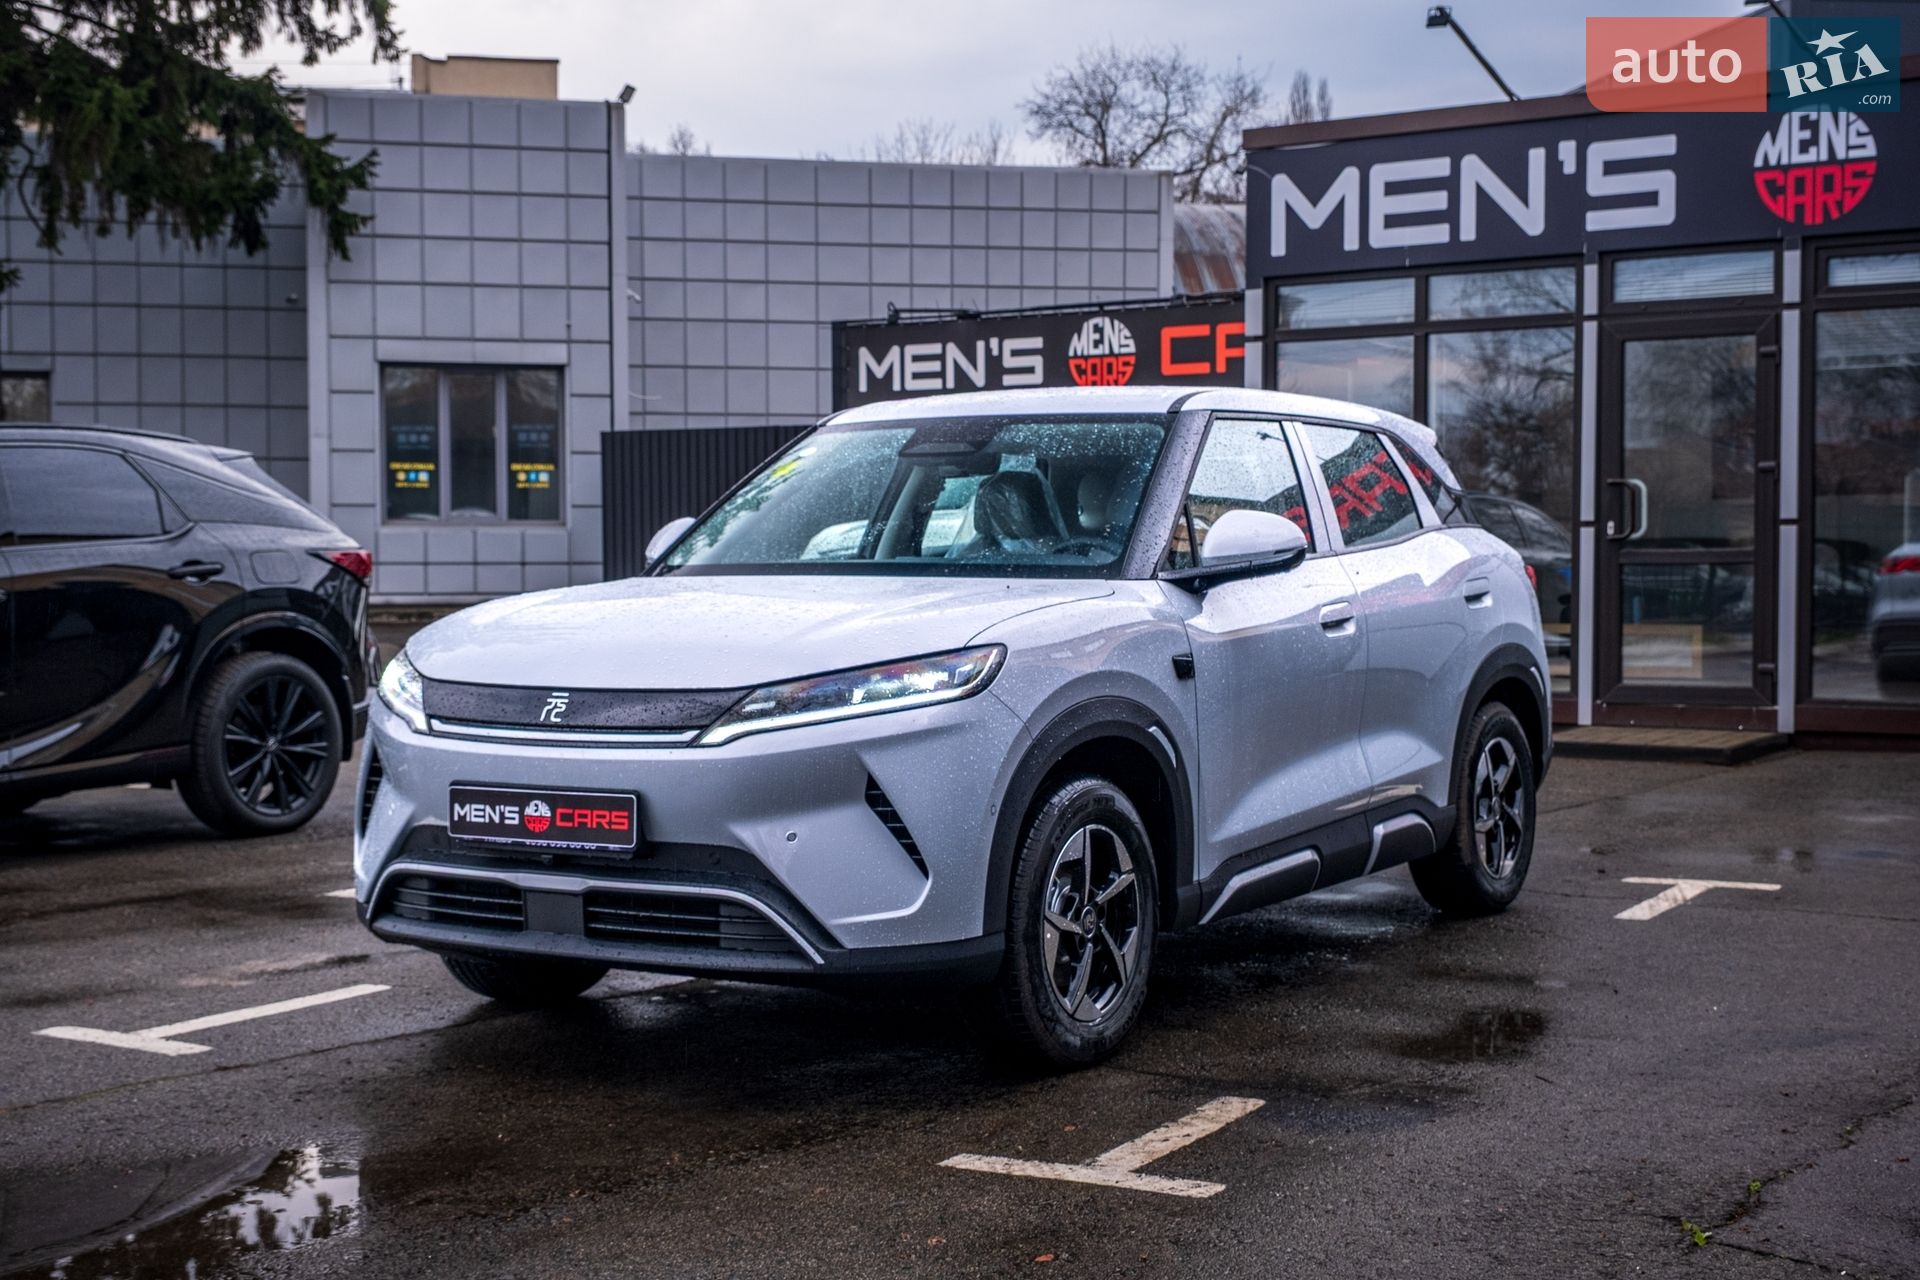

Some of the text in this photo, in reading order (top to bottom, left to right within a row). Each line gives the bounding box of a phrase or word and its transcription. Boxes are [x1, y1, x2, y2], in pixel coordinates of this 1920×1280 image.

[1270, 134, 1678, 258] MEN'S
[1753, 160, 1878, 226] CARS
[858, 336, 1044, 393] MEN'S
[1068, 355, 1136, 387] CARS
[453, 803, 629, 830] MEN'S CARS
